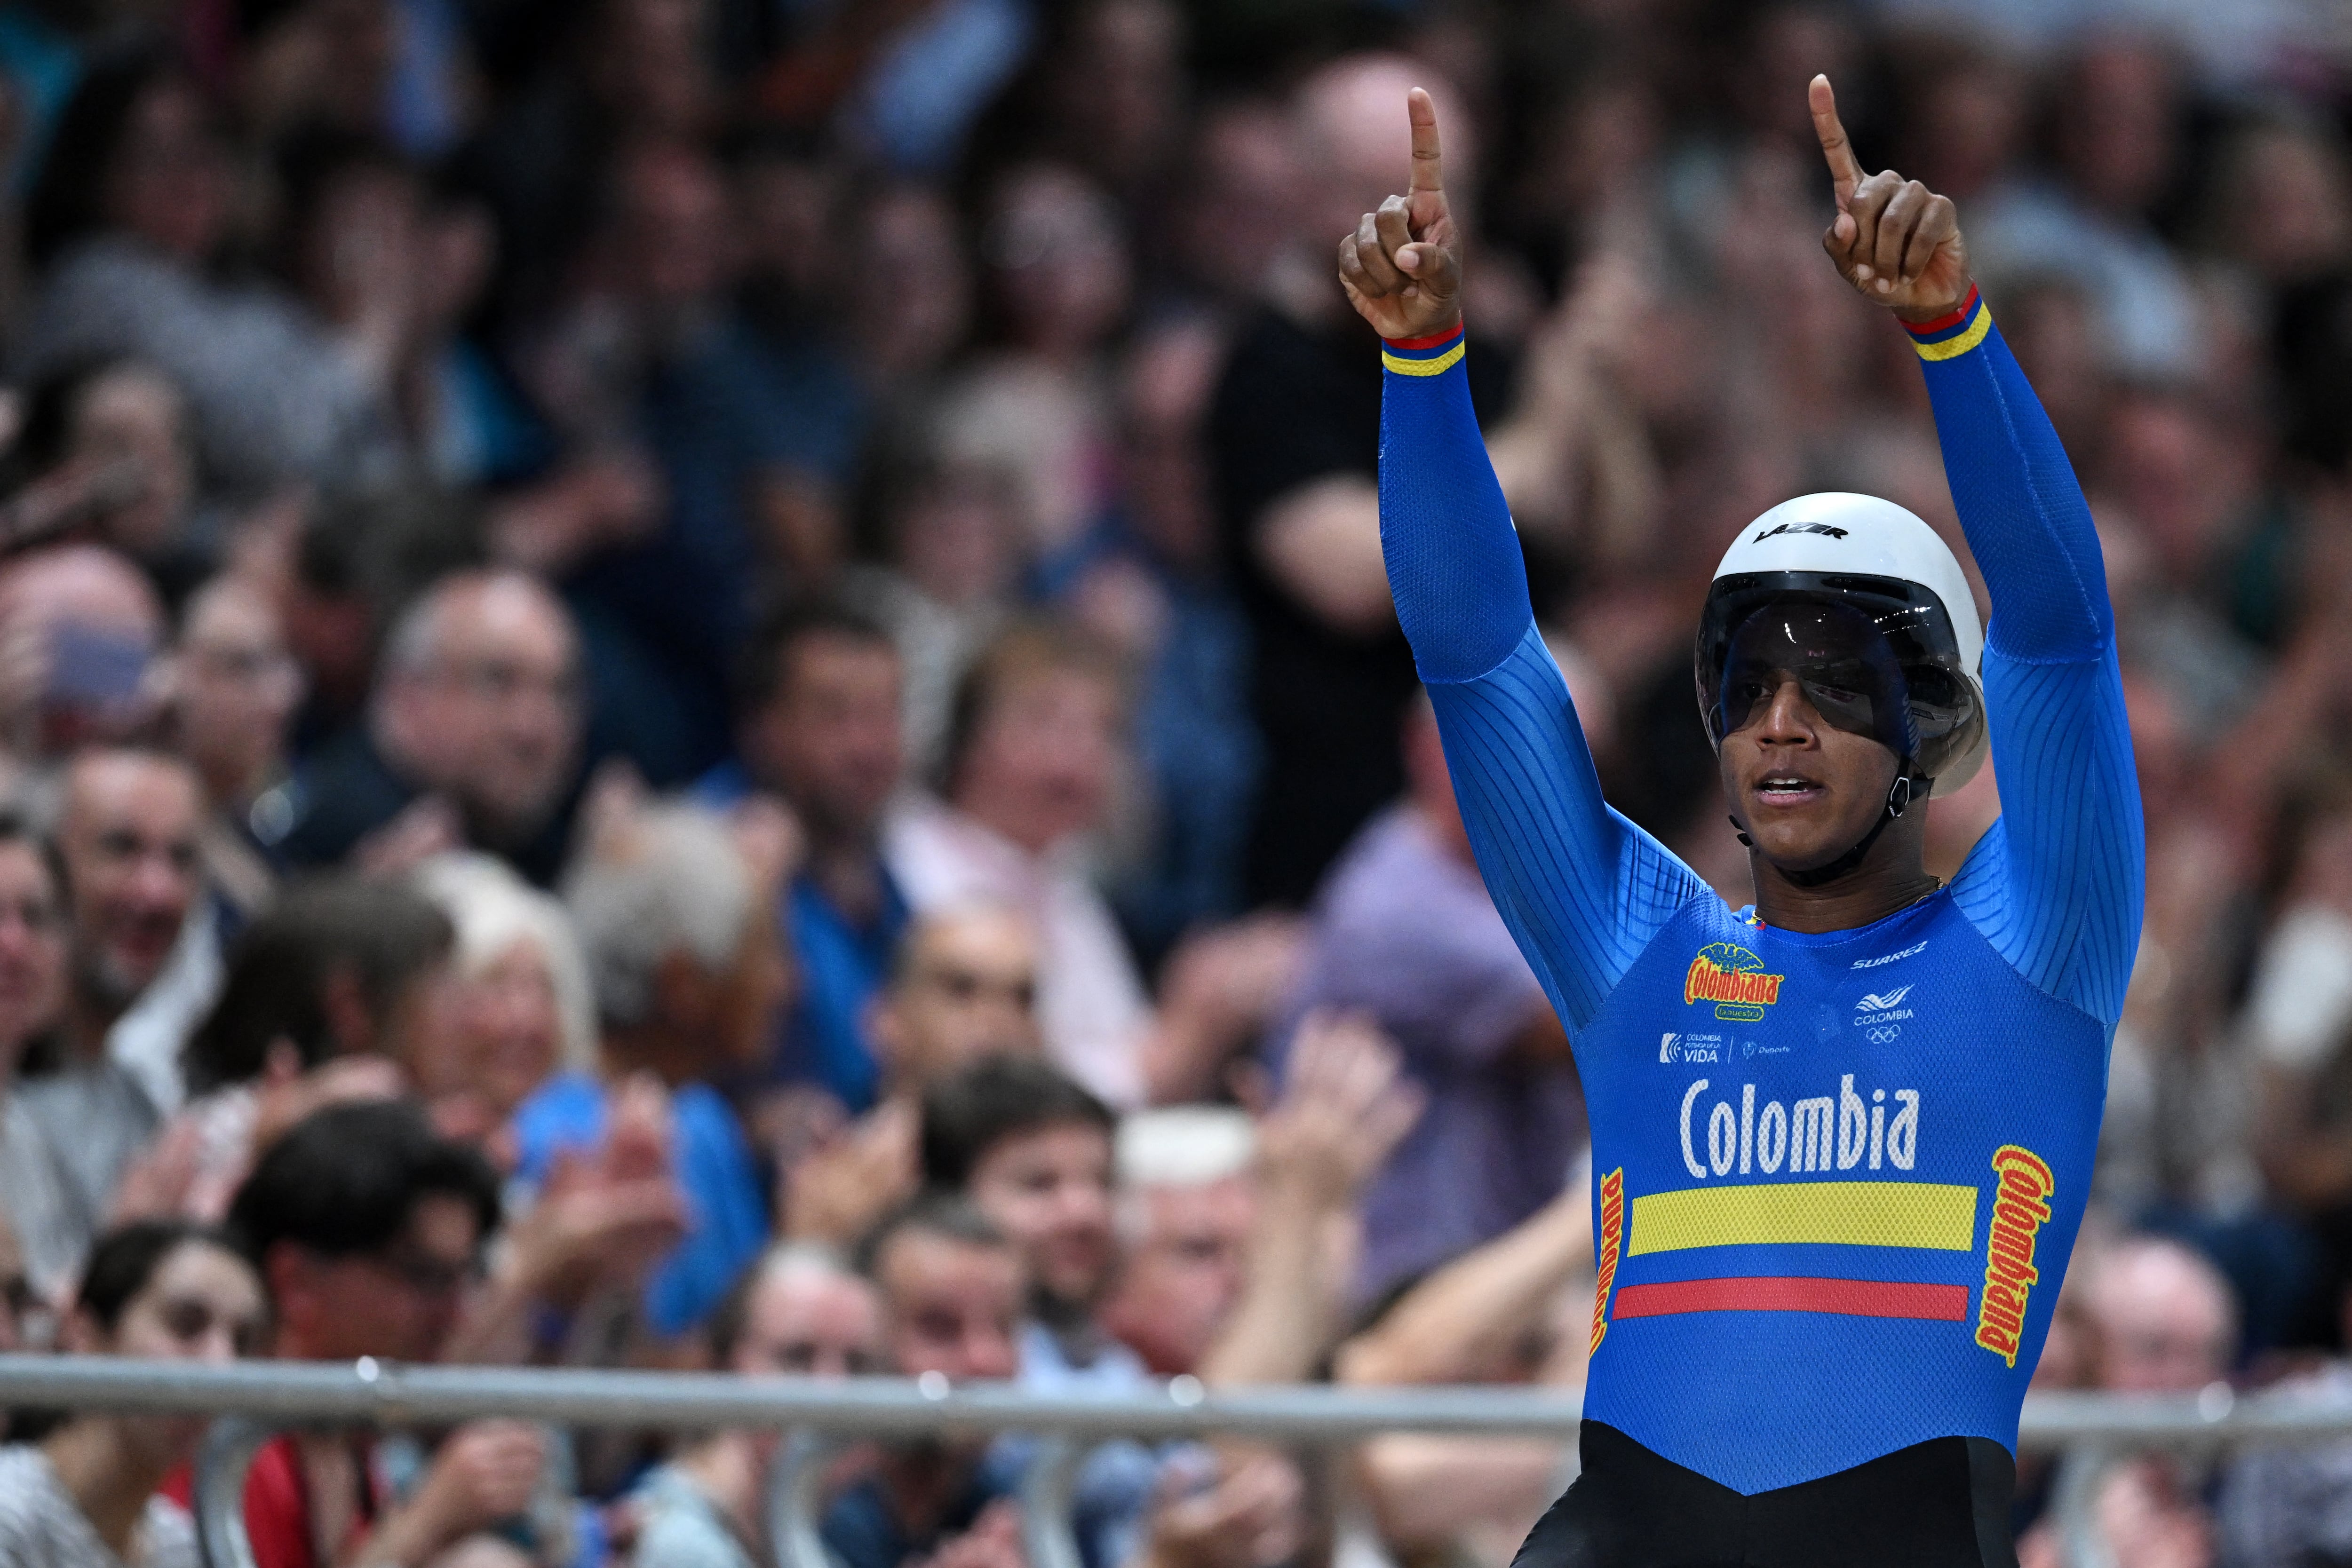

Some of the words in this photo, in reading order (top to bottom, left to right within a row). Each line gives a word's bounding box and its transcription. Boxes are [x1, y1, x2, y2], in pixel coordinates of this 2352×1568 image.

[1752, 522, 1849, 544] LAZER
[1850, 940, 1928, 969] SUAREZ
[1685, 958, 1778, 1003] Colombiana
[1854, 1008, 1914, 1026] COLOMBIA
[1684, 1049, 1718, 1063] VIDA
[1680, 1073, 1920, 1179] Colombia
[1978, 1149, 2052, 1355] Colombiana
